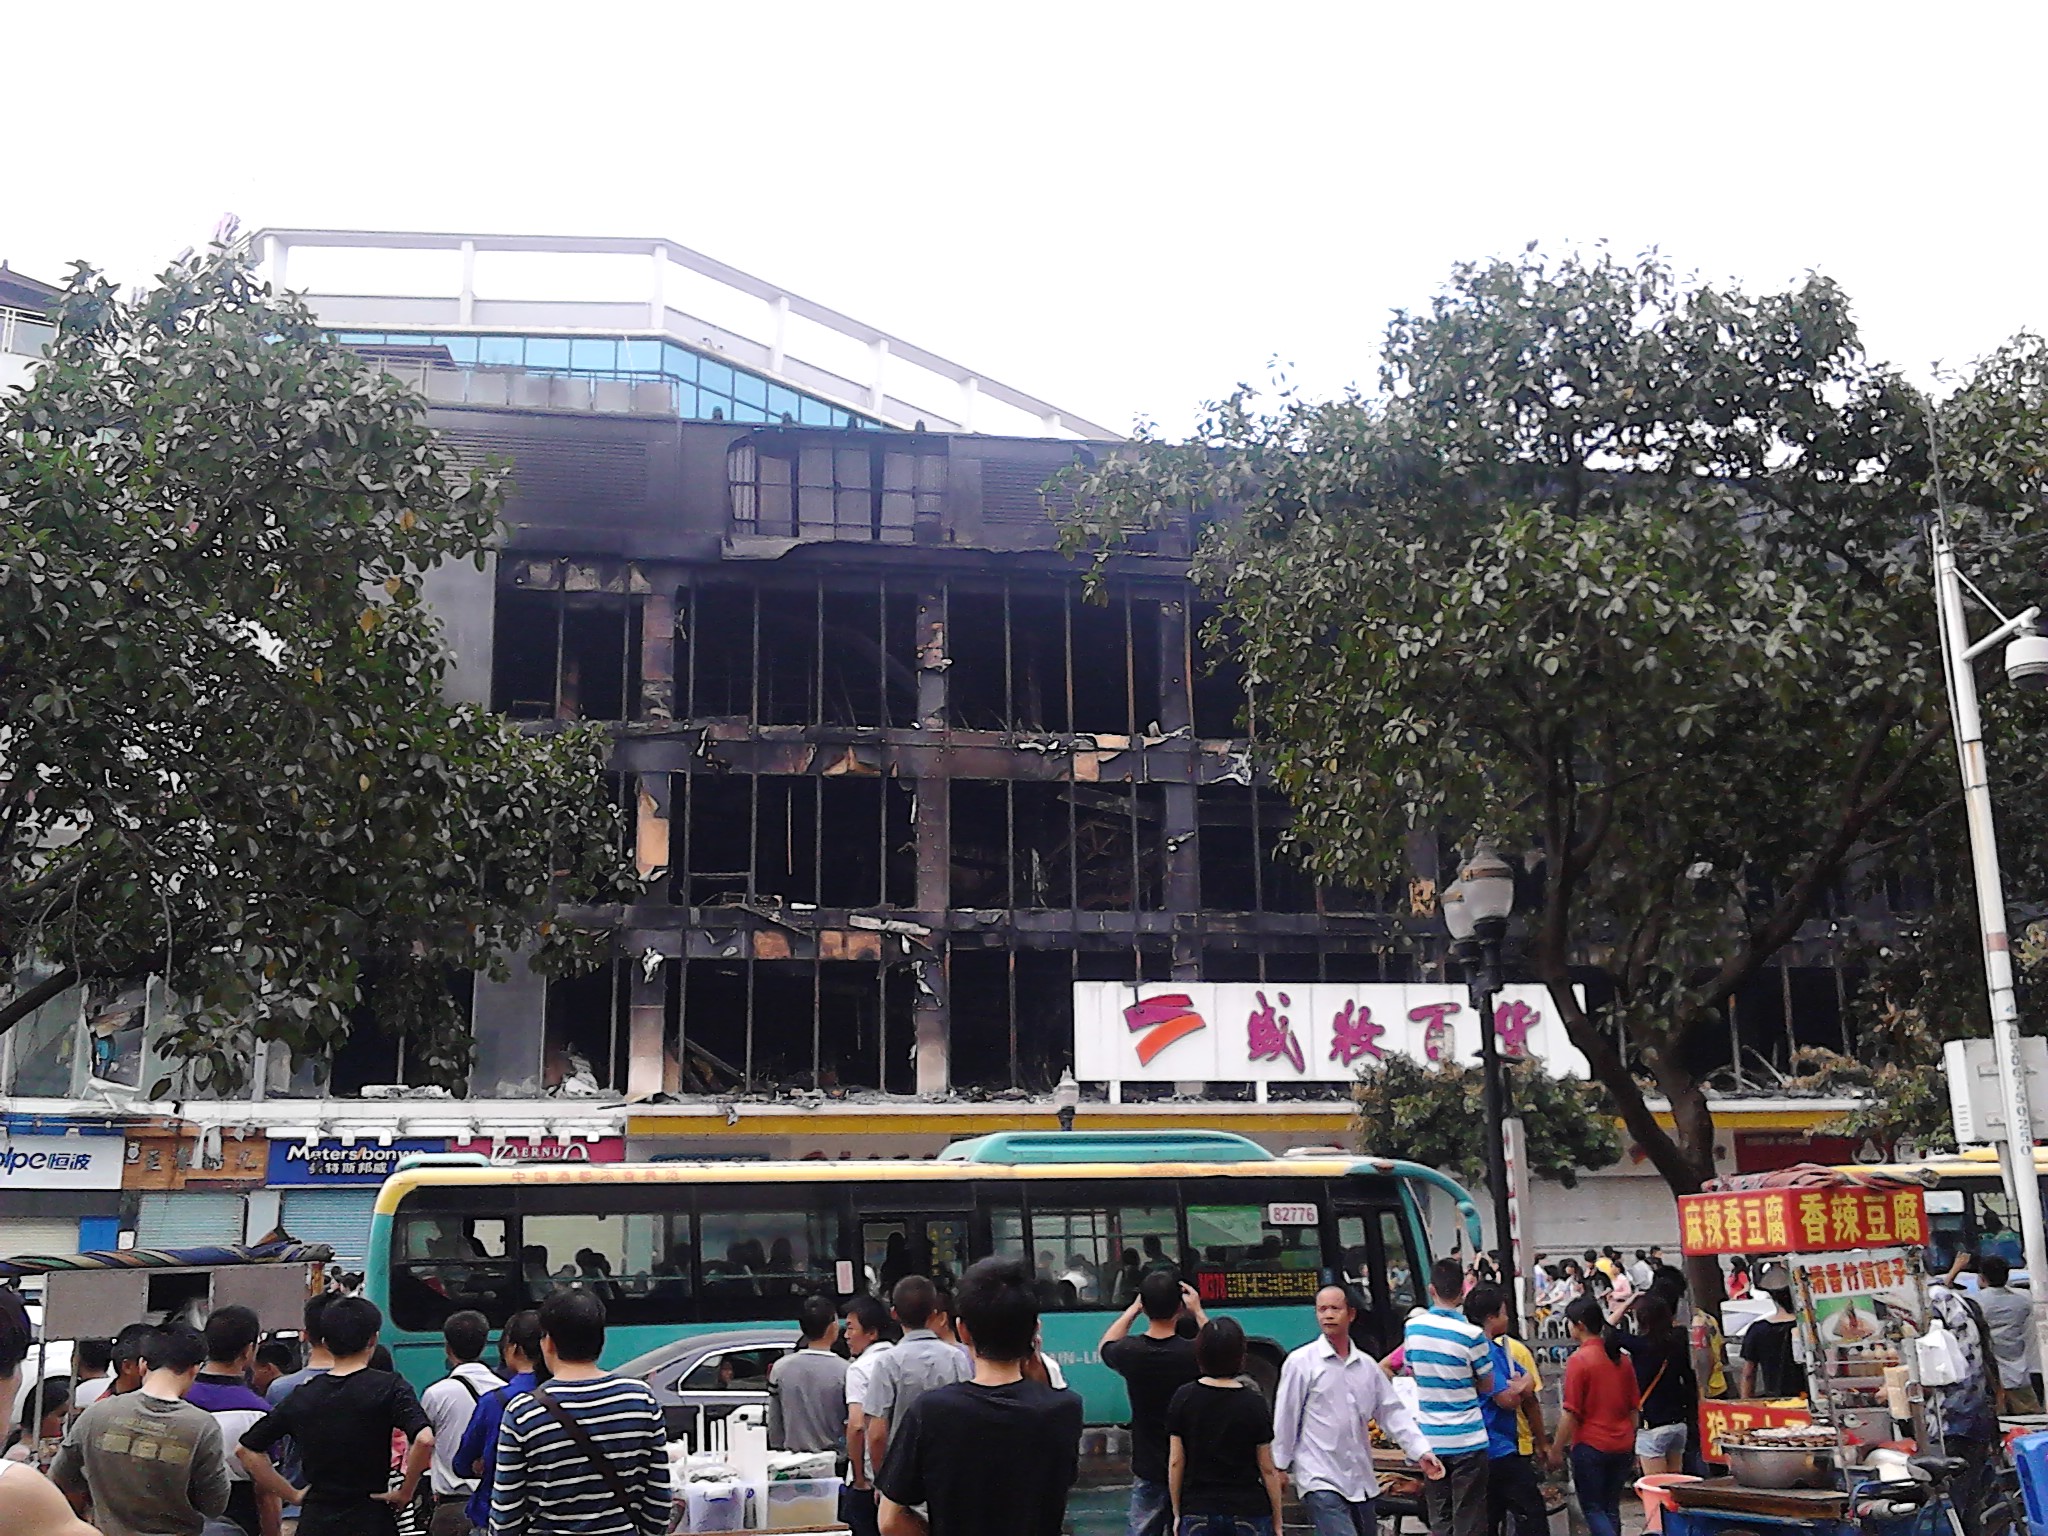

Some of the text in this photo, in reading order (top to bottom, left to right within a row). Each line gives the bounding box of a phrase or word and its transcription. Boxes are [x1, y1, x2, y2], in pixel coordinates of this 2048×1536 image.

[0, 1147, 92, 1175] lpe 恒波
[1273, 1206, 1316, 1222] 82776
[1684, 1194, 1787, 1250] 麻辣香豆腐
[1799, 1191, 1922, 1245] 香辣豆腐
